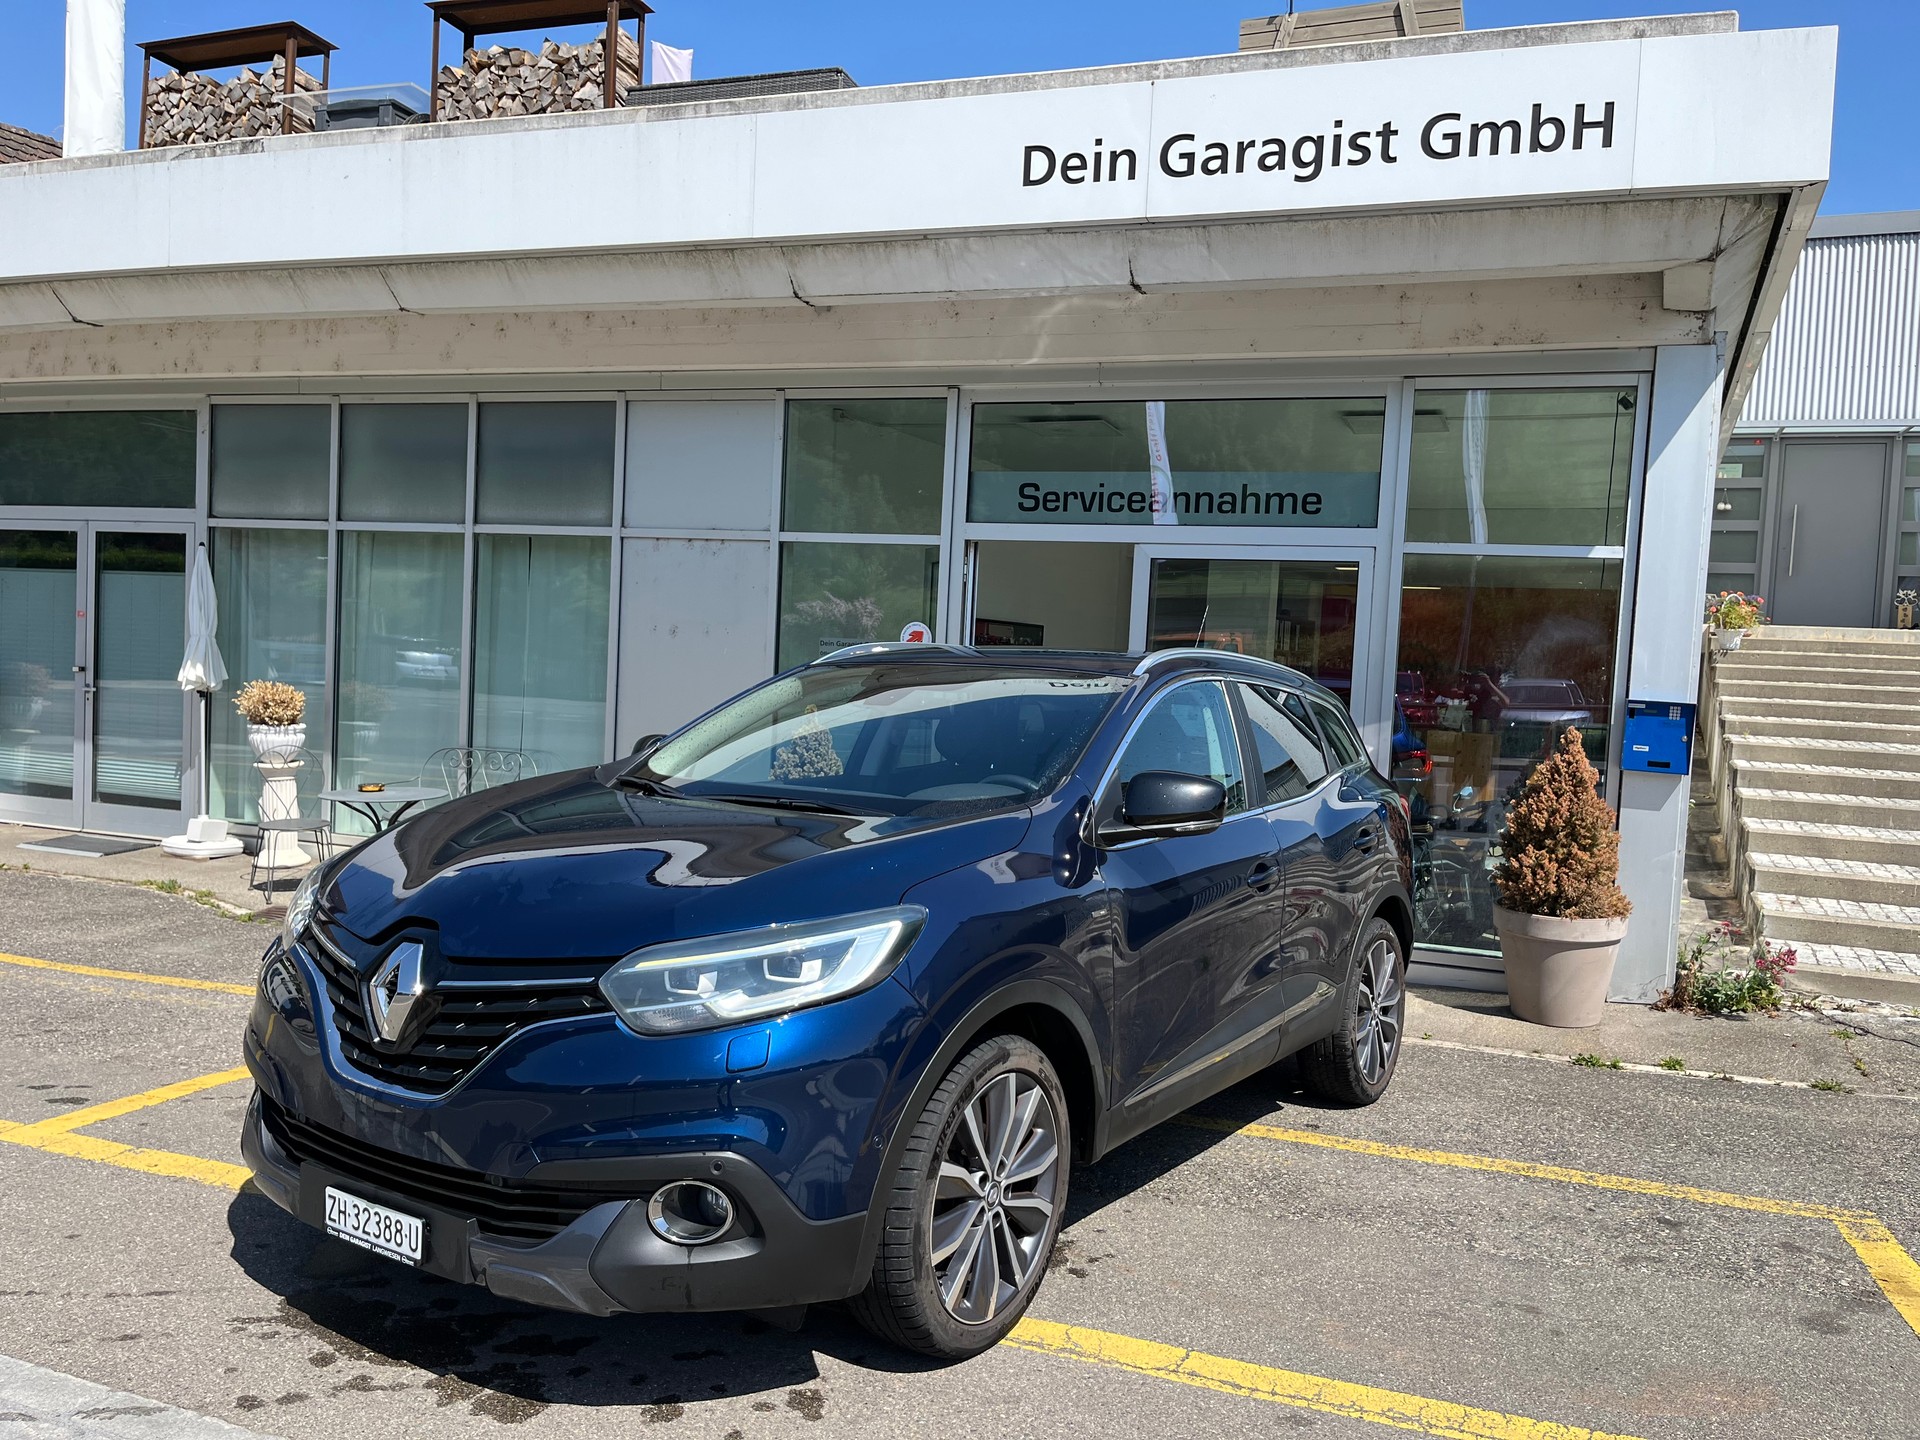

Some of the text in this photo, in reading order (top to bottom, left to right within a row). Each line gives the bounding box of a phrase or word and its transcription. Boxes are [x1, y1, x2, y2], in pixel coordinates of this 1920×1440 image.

[1022, 101, 1615, 187] Dein Garagist GmbH
[1017, 482, 1323, 515] Serviceannahme
